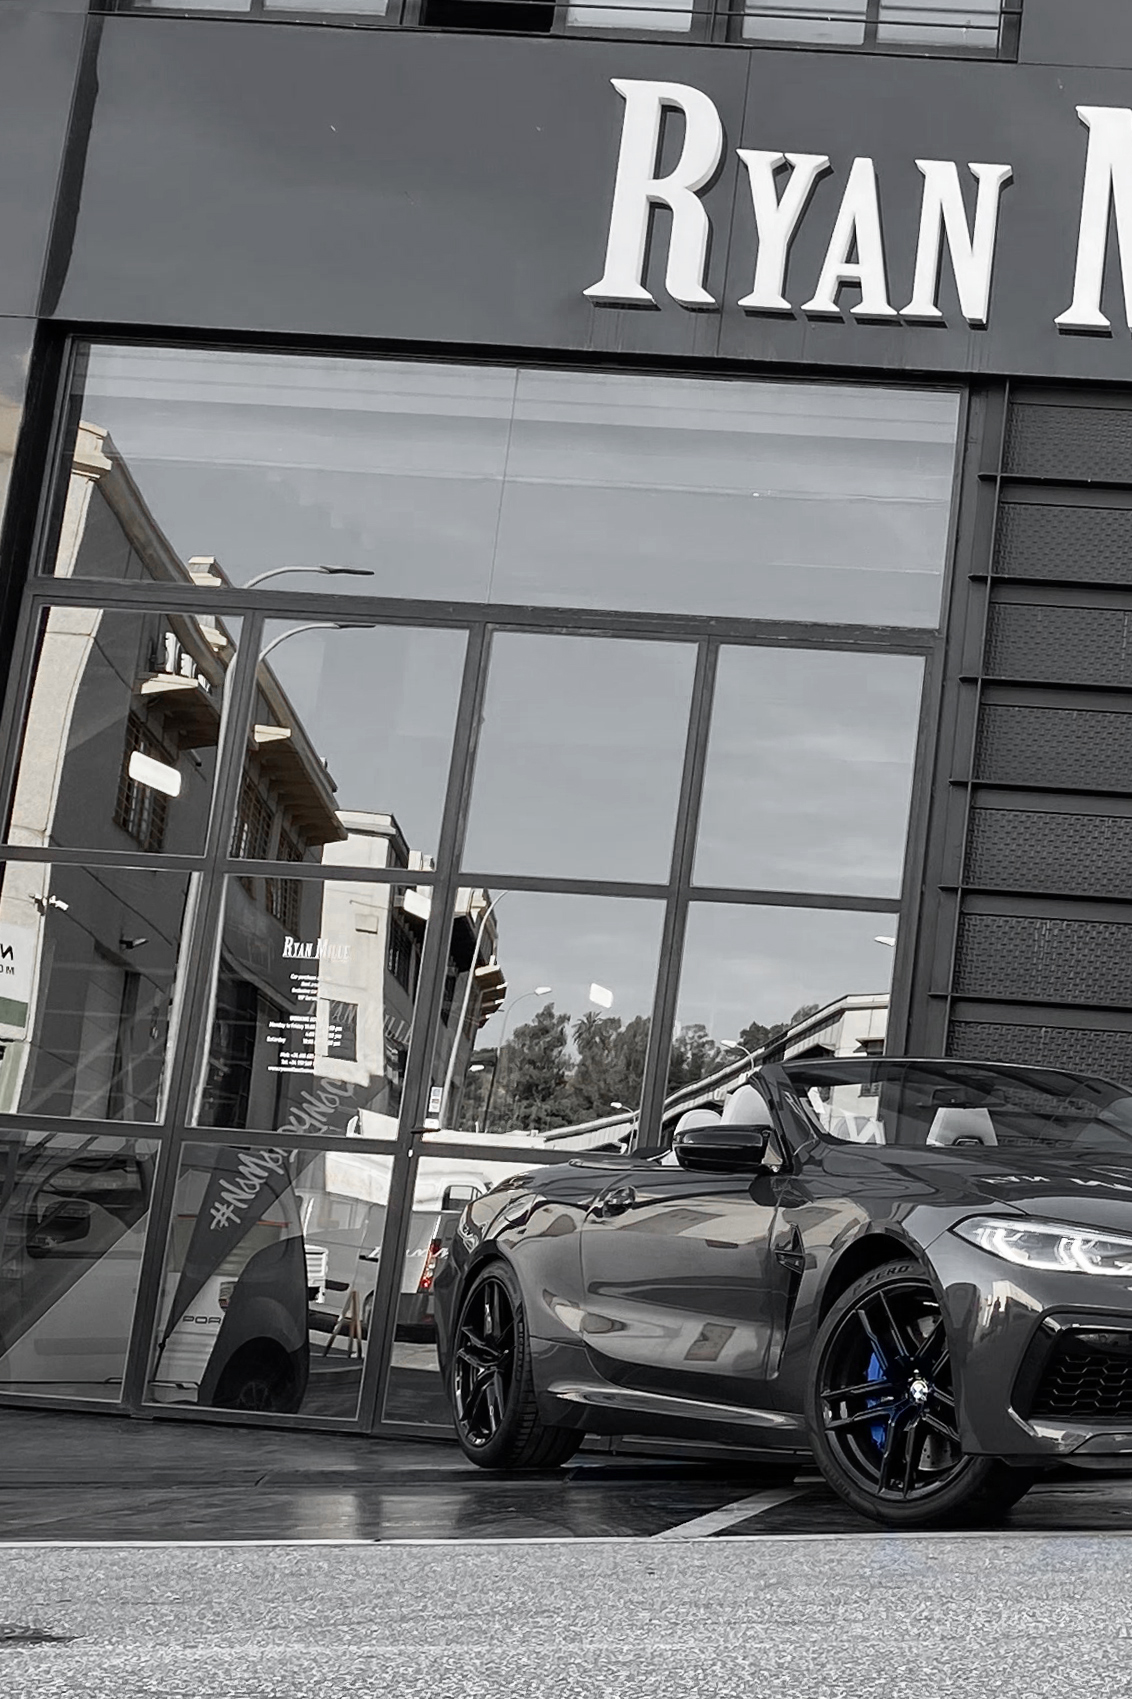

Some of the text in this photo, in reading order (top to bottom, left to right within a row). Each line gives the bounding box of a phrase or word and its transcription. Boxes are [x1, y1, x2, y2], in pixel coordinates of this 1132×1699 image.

[583, 78, 1012, 330] RYAN
[282, 936, 314, 958] RYAN
[183, 1316, 221, 1324] POR
